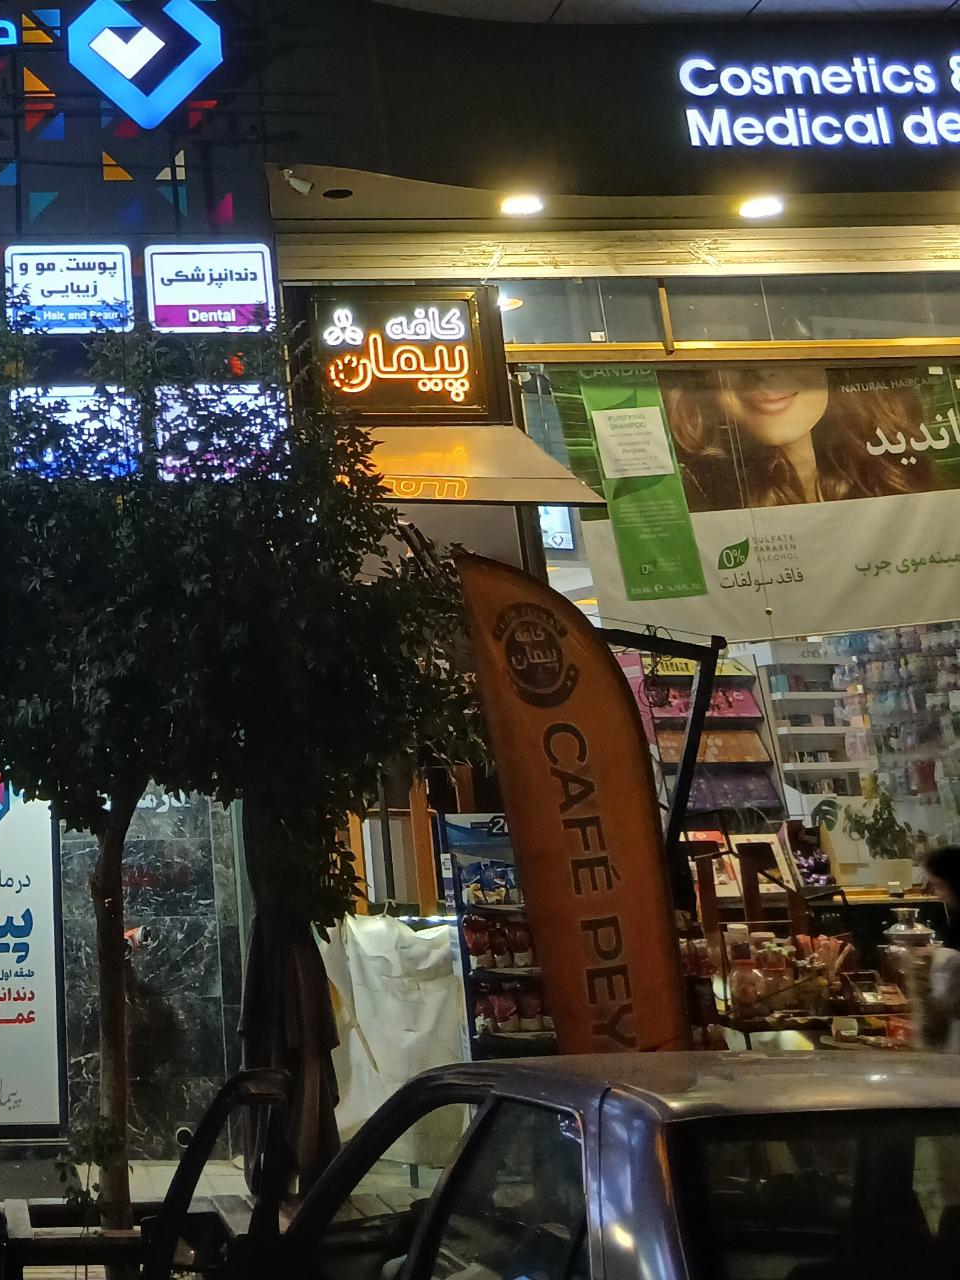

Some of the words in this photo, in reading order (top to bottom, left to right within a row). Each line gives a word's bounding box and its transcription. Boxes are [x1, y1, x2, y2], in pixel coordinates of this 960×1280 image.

[679, 56, 936, 97] Cosmetics
[685, 106, 892, 147] Medical
[19, 261, 29, 276] و
[35, 261, 57, 277] مو
[160, 267, 258, 288] دندانپزشکی
[40, 280, 98, 298] زیبایی
[68, 310, 87, 320] and
[188, 308, 236, 323] Dental
[385, 307, 466, 340] کافه
[329, 332, 470, 402] پیمان
[840, 380, 889, 393] NATURAL
[722, 547, 746, 568] 0%
[895, 558, 927, 574] موی
[719, 569, 773, 592] سولفات
[778, 567, 804, 584] فاقد
[541, 722, 624, 897] CAFÉ
[14, 967, 35, 980] طبقه
